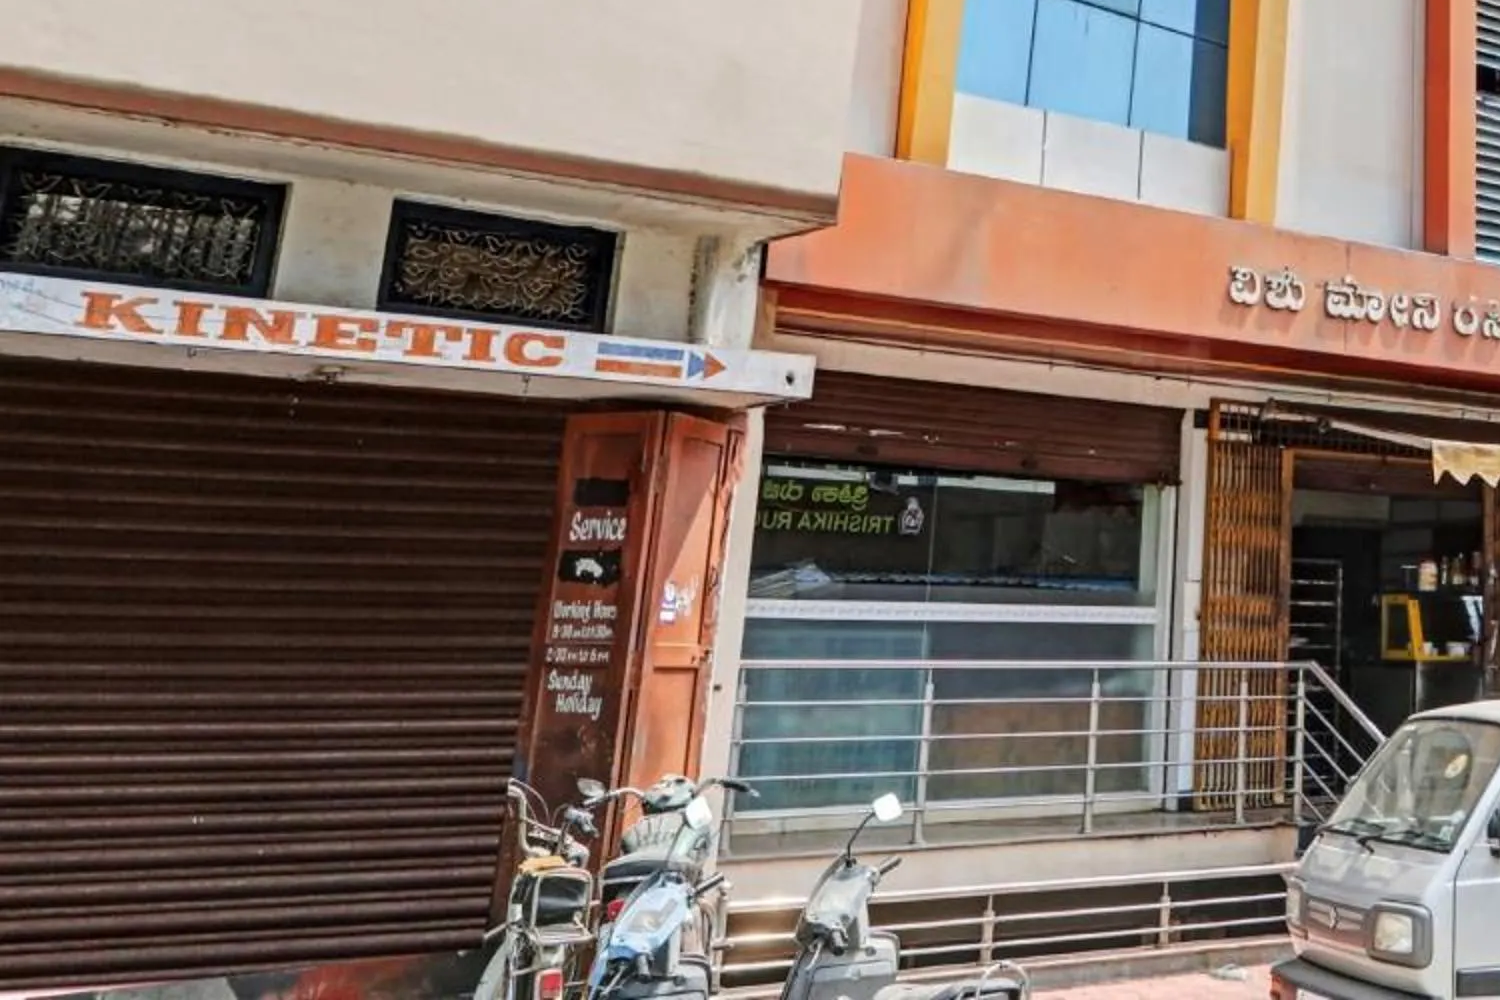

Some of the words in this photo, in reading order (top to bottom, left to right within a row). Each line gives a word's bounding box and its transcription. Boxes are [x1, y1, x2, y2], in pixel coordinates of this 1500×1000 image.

[73, 290, 567, 368] KINETIC
[569, 510, 627, 542] Service
[547, 667, 593, 697] Sunday
